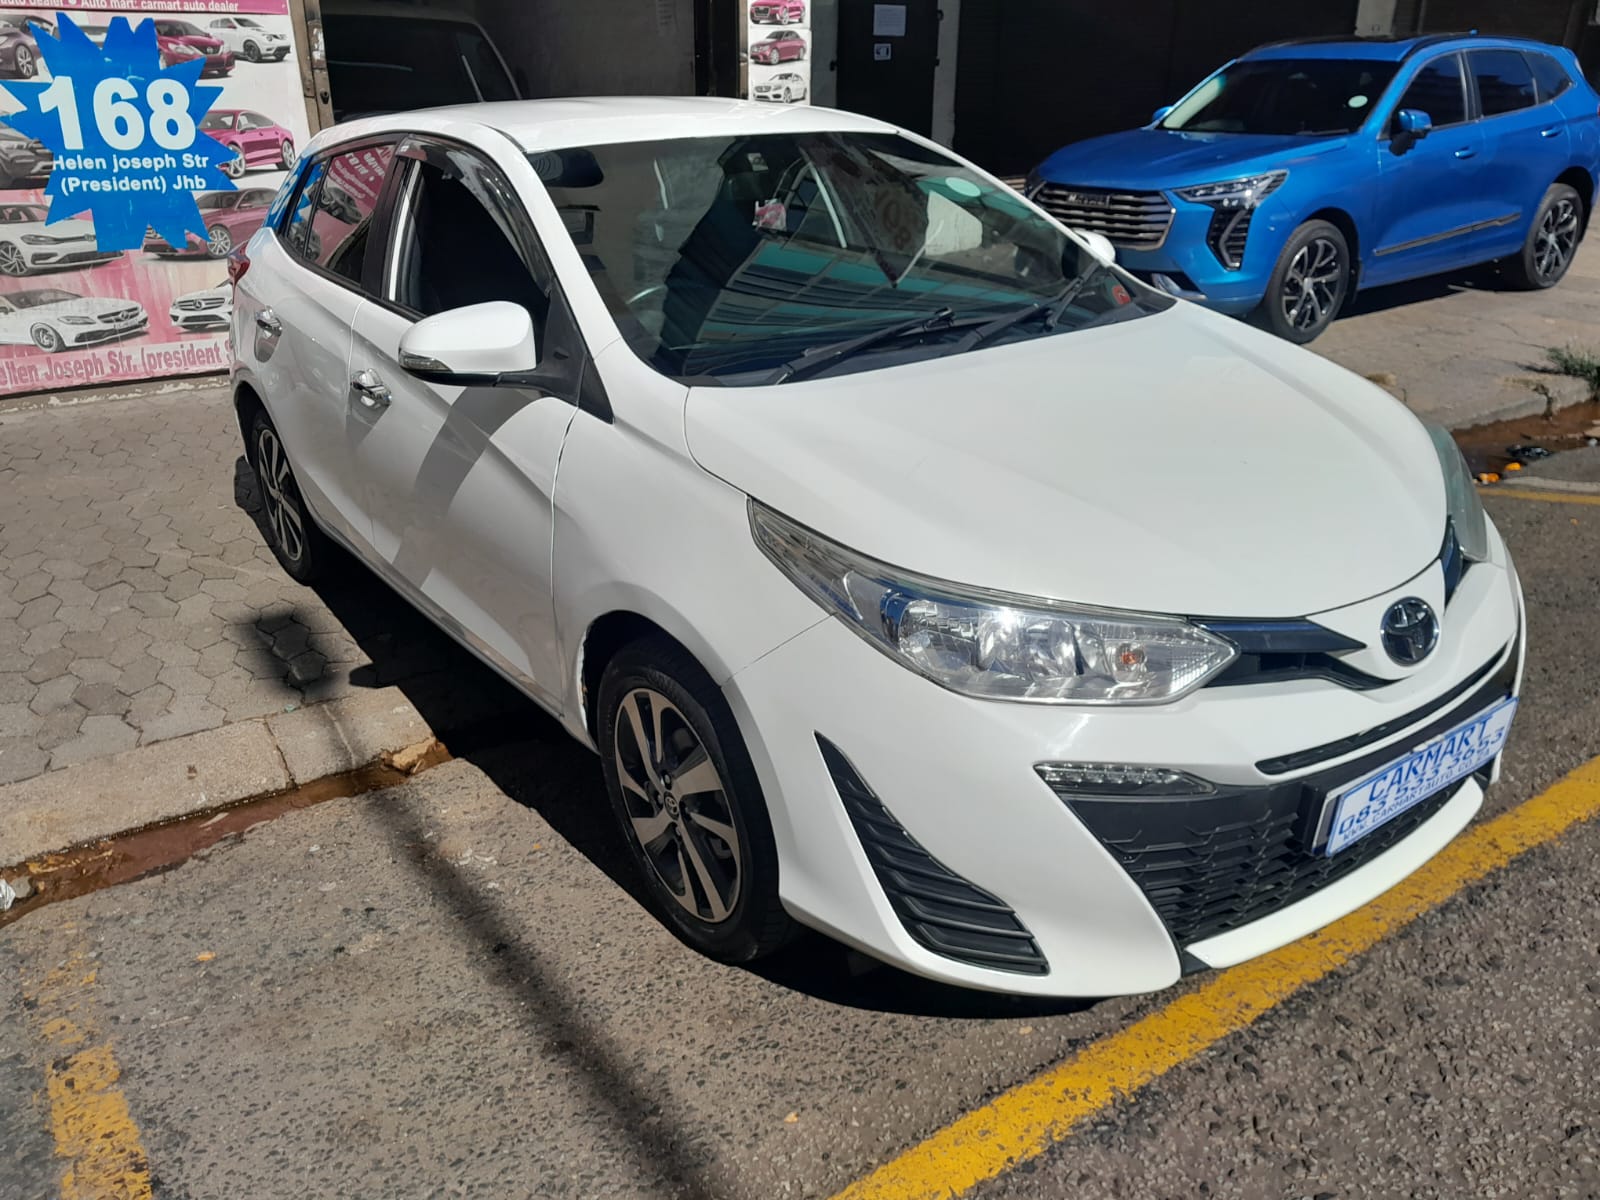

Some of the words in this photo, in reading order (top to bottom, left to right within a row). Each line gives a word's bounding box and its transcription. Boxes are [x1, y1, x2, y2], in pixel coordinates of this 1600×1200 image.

[140, 0, 181, 11] carmart
[183, 1, 206, 11] auto
[208, 1, 239, 12] dealer
[38, 76, 196, 150] 168
[53, 154, 107, 170] Helen
[182, 153, 209, 168] Str
[61, 176, 167, 196] (President)
[172, 175, 207, 190] Jhb
[44, 352, 105, 382] Joseph
[107, 350, 138, 374] Str.
[140, 342, 222, 376] (president
[1368, 714, 1493, 803] CARMART
[1338, 795, 1387, 835] 083
